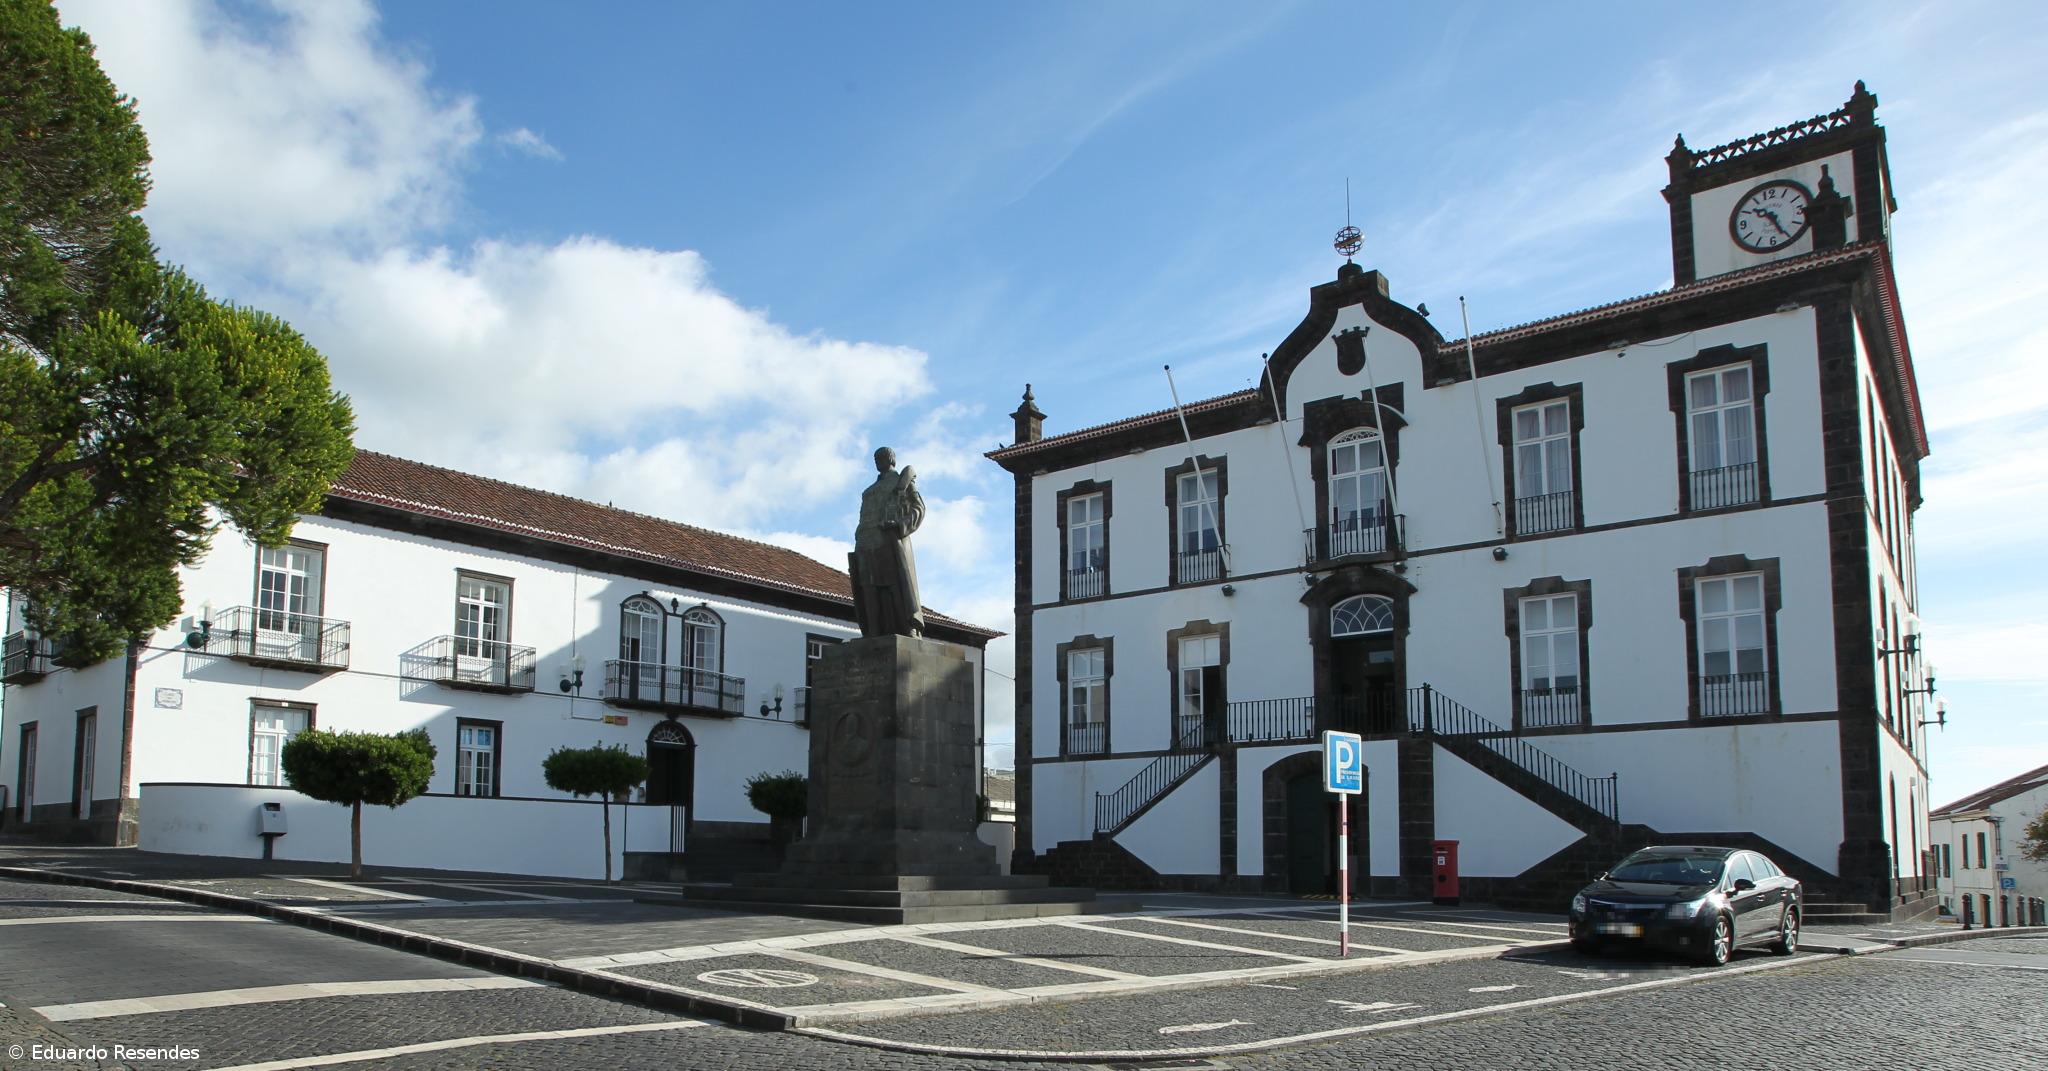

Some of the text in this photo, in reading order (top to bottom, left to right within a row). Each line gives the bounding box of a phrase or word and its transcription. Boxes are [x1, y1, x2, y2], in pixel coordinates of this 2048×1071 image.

[1762, 188, 1776, 201] 12
[1796, 205, 1805, 215] 3
[1740, 220, 1747, 230] 9
[1769, 237, 1777, 246] 6
[1335, 740, 1354, 784] P
